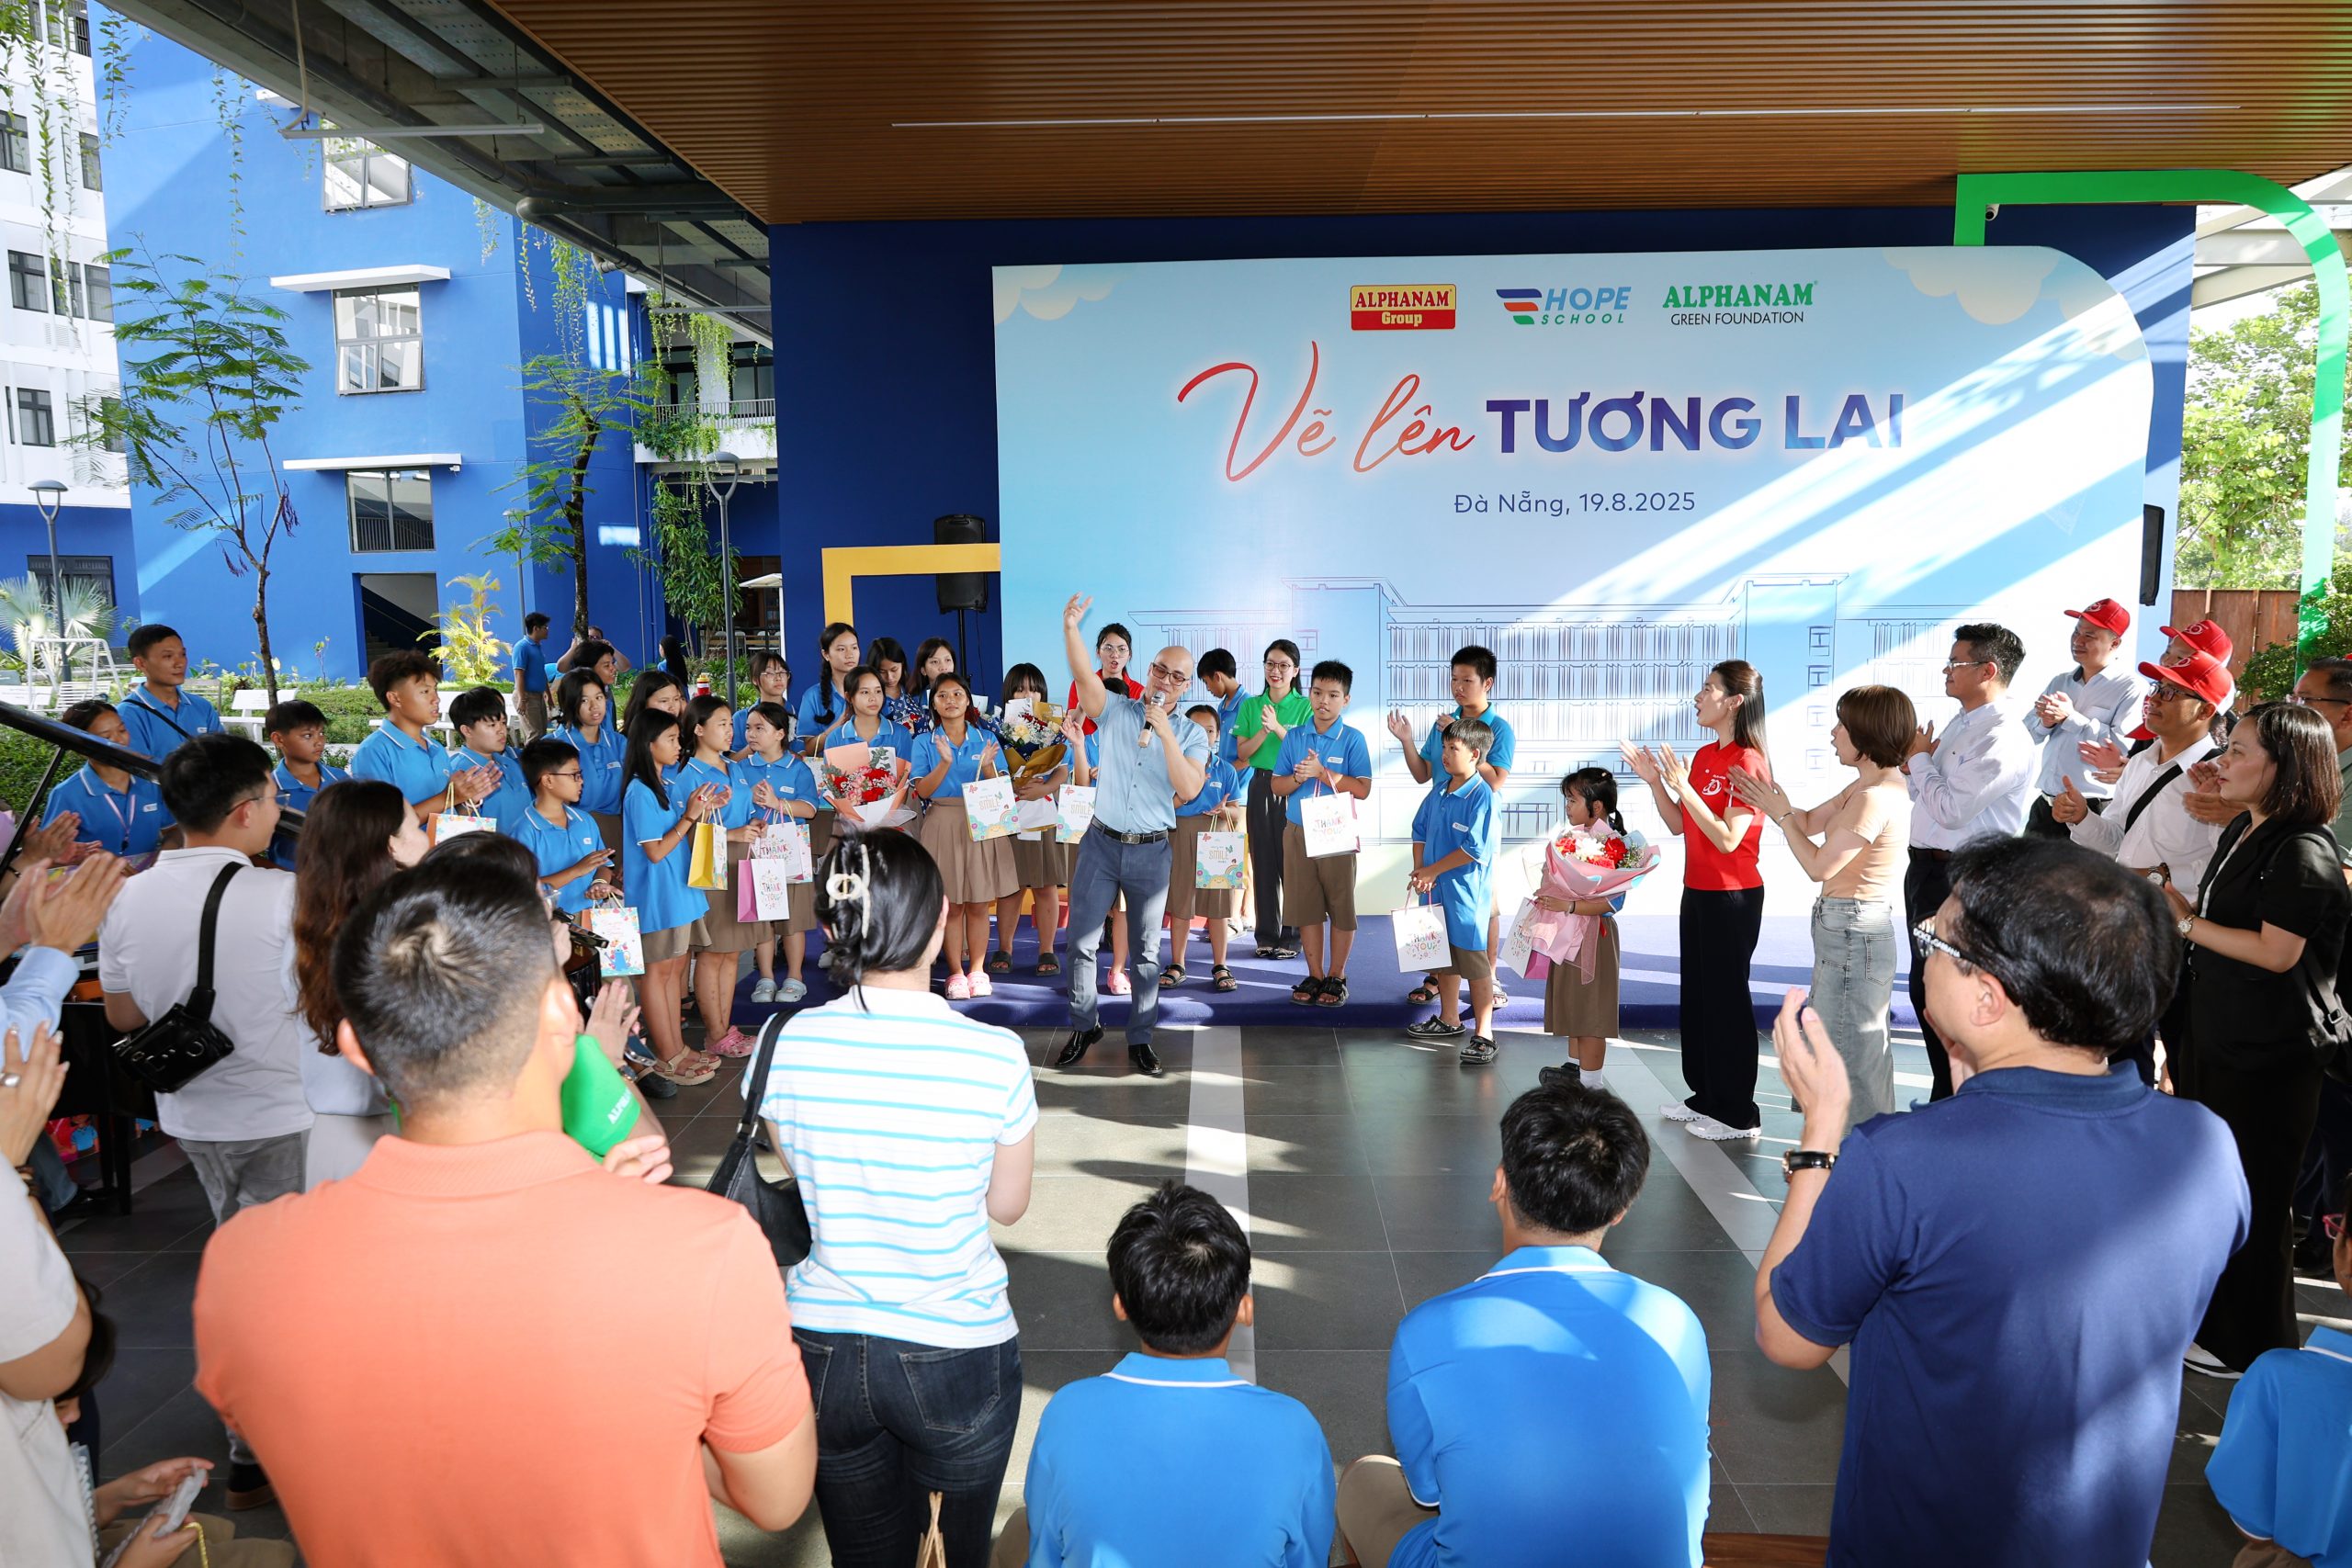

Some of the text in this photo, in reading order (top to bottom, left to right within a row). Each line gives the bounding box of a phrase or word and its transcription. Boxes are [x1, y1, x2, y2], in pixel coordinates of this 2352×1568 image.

[1355, 290, 1449, 308] ALPHANAM
[1544, 287, 1632, 310] HOPE
[1662, 283, 1814, 309] ALPHANAM
[1381, 311, 1423, 327] Group
[1541, 313, 1624, 325] SCHOOL
[1670, 311, 1804, 325] GREEN FOUNDATION
[1177, 340, 1905, 482] Vẽ lên TƯƠNG LAI
[1454, 491, 1696, 517] Đà Nẵng, 19.8.2025
